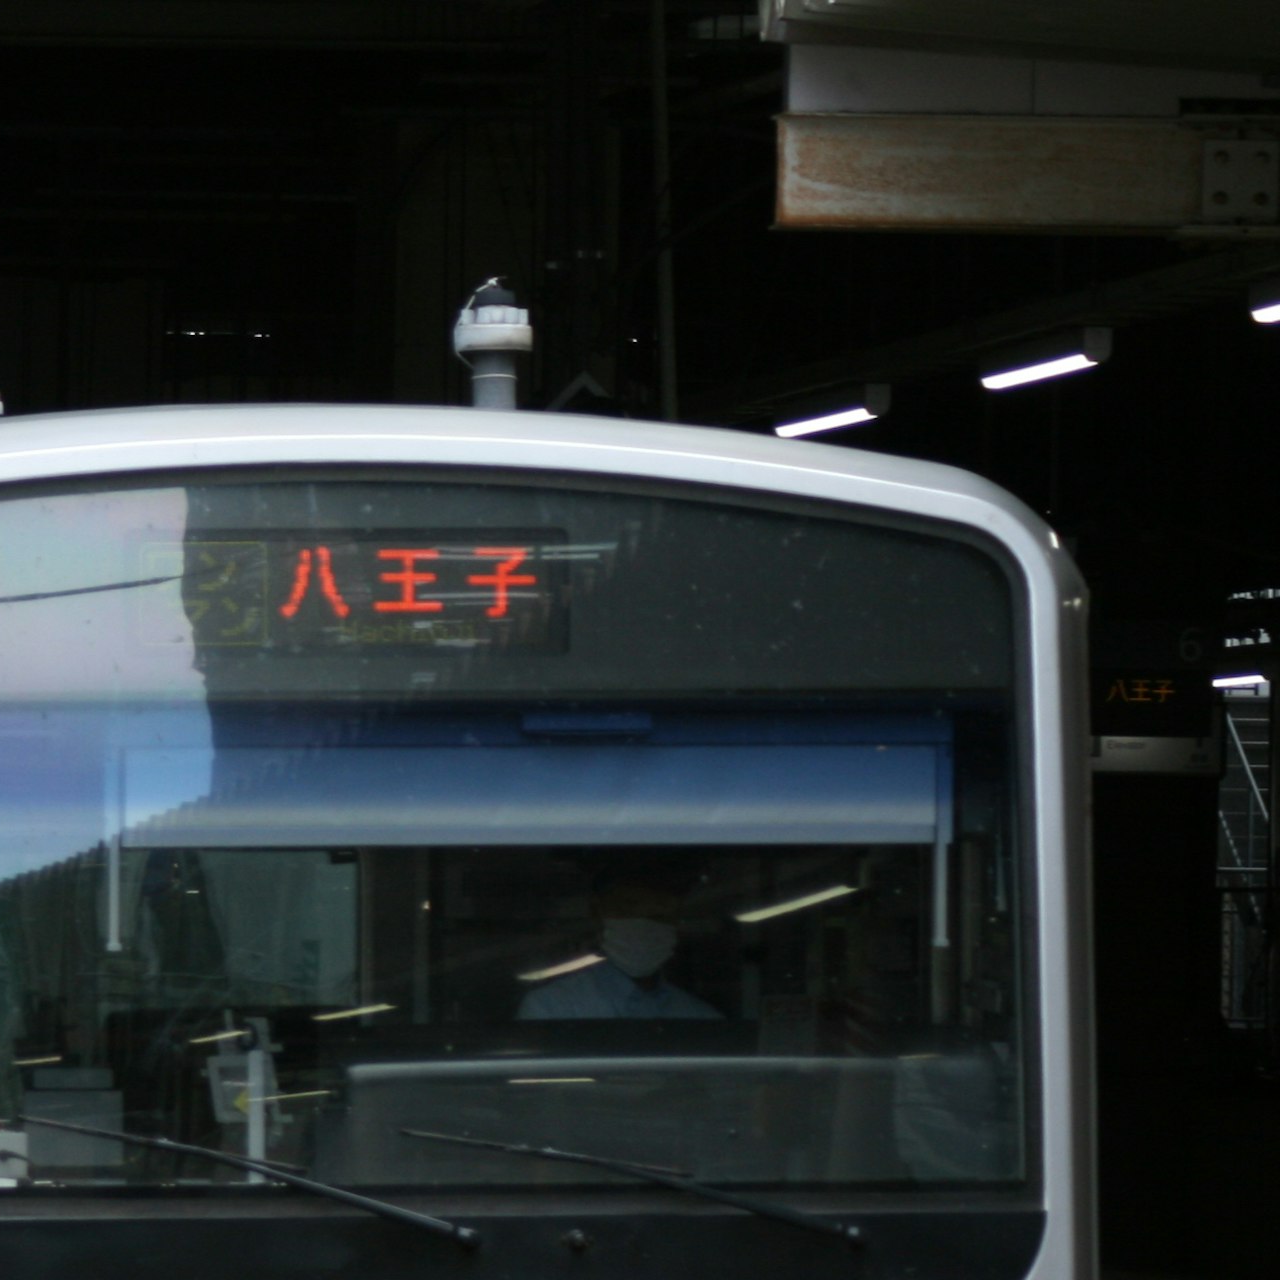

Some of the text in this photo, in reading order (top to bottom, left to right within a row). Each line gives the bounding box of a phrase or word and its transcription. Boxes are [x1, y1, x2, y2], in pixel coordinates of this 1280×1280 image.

[278, 545, 538, 618] 八王子
[1107, 678, 1176, 703] 八王子
